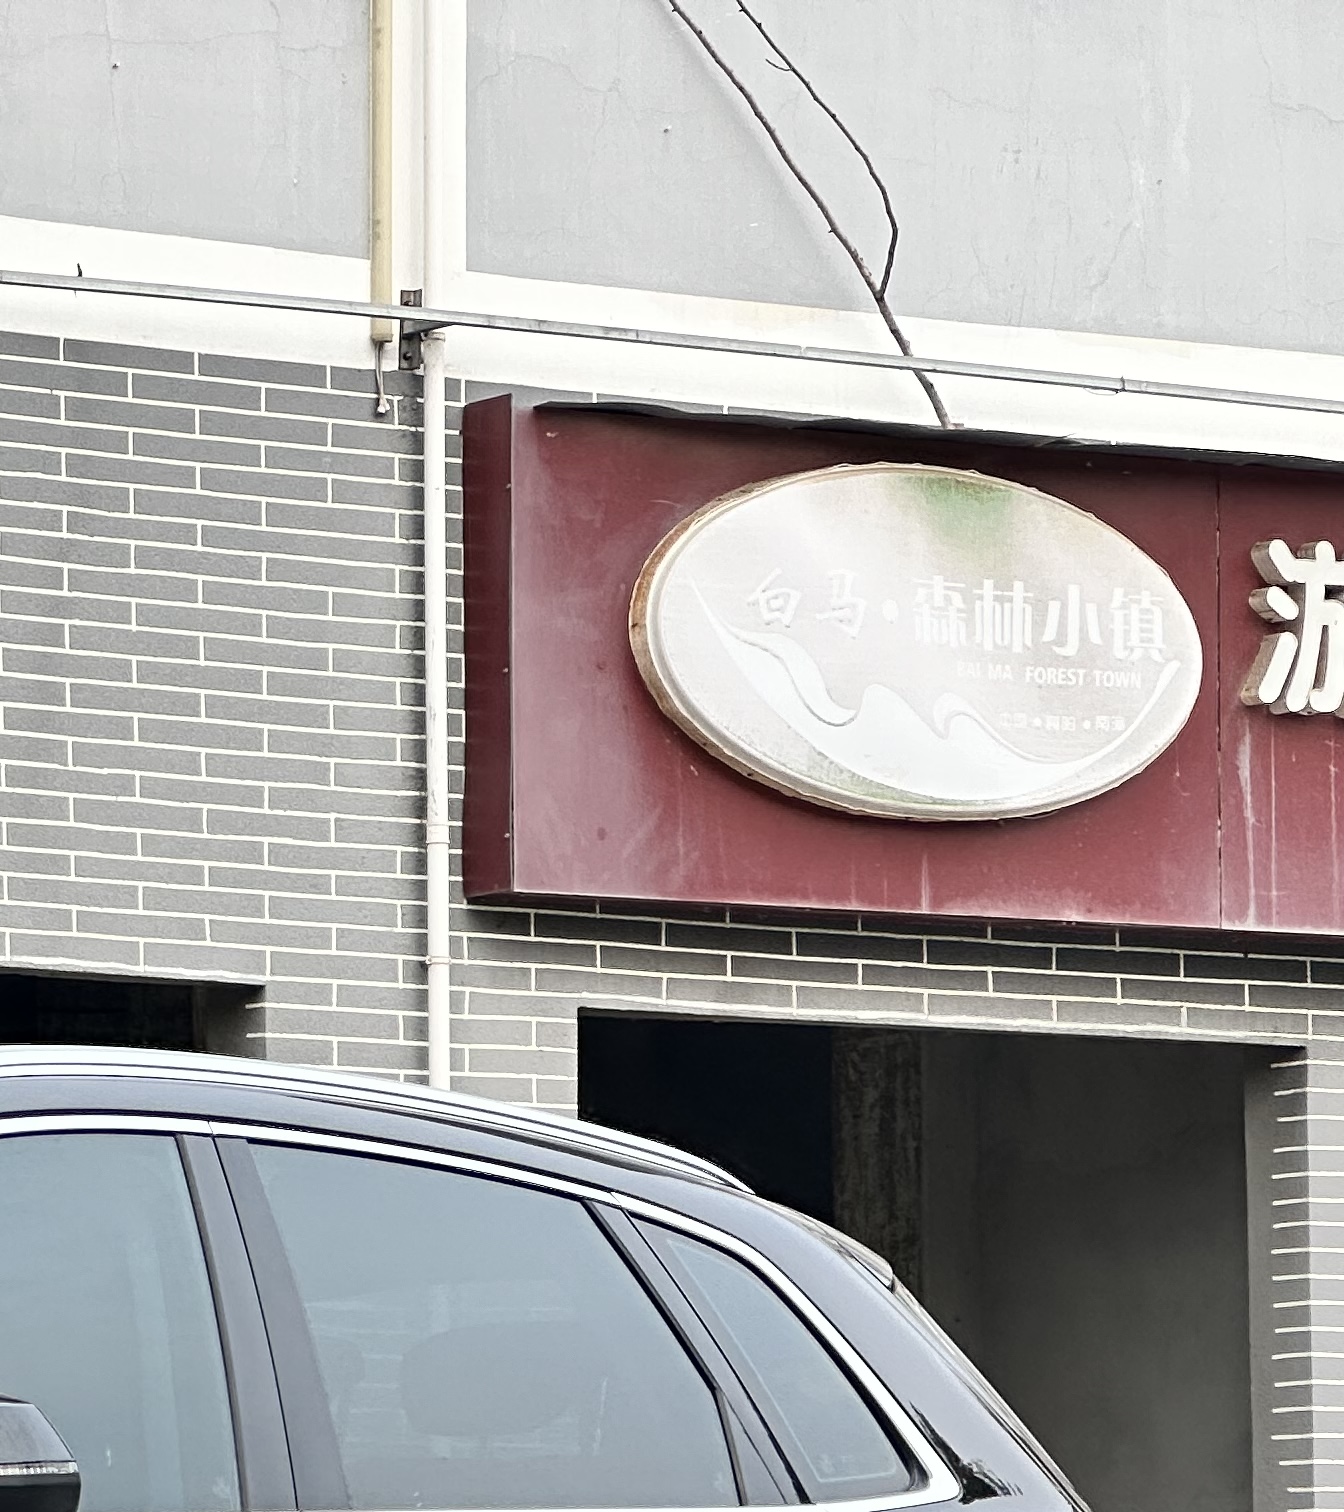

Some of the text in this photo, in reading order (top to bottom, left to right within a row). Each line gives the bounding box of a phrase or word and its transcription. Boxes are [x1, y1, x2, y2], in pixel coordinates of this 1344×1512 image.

[988, 663, 1014, 681] MA
[1025, 665, 1087, 686] FOREST
[1093, 669, 1142, 690] TOWN
